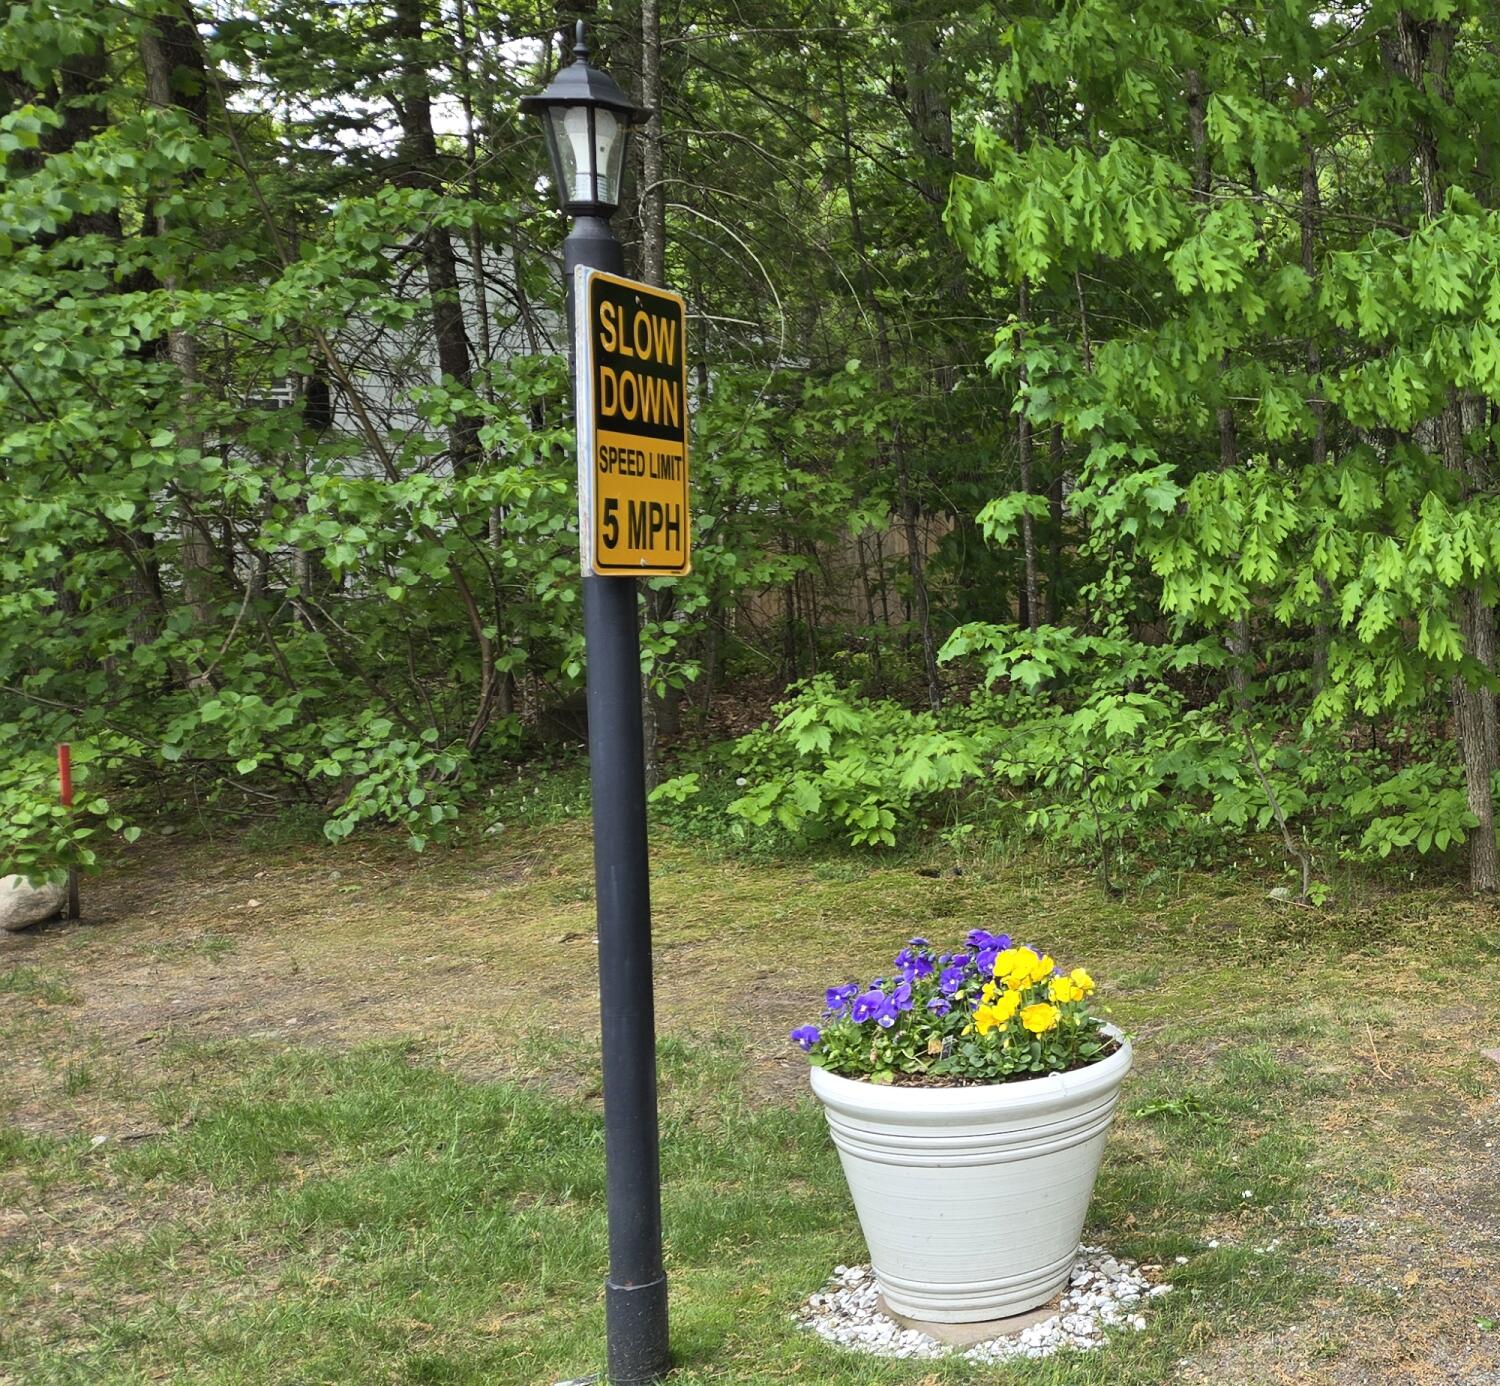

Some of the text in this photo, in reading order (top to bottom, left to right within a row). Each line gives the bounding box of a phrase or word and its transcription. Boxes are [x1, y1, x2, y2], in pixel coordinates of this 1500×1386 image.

[600, 300, 676, 366] SLOW
[600, 365, 679, 428] DOWN
[600, 445, 683, 481] SPEED LIMIT
[602, 497, 680, 551] 5 MPH
